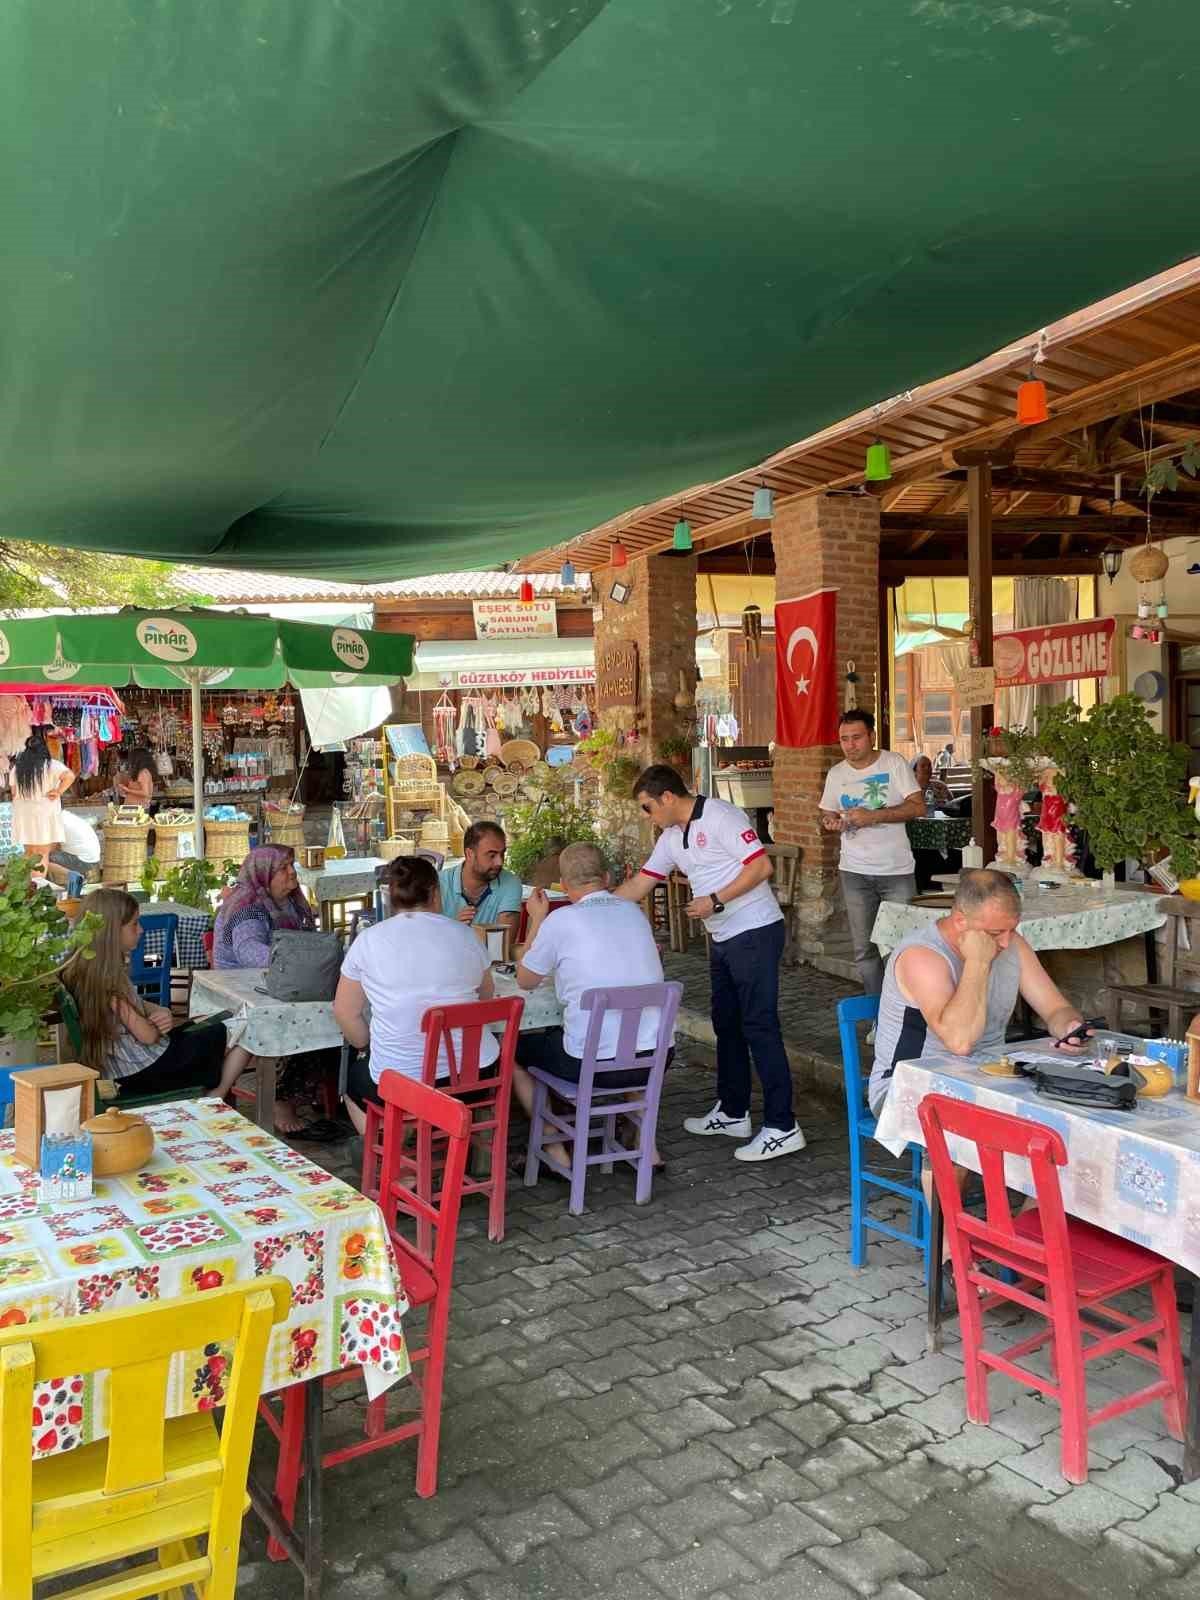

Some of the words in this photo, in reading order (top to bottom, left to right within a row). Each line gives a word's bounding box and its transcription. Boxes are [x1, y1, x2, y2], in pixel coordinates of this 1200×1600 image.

[479, 604, 512, 614] EŞEK
[490, 615, 537, 623] SABUNU
[489, 626, 534, 634] SATILIR
[1027, 629, 1107, 679] GÖZLEME
[460, 671, 526, 684] GÜZELKÖY
[531, 669, 596, 680] HEDİYELİK
